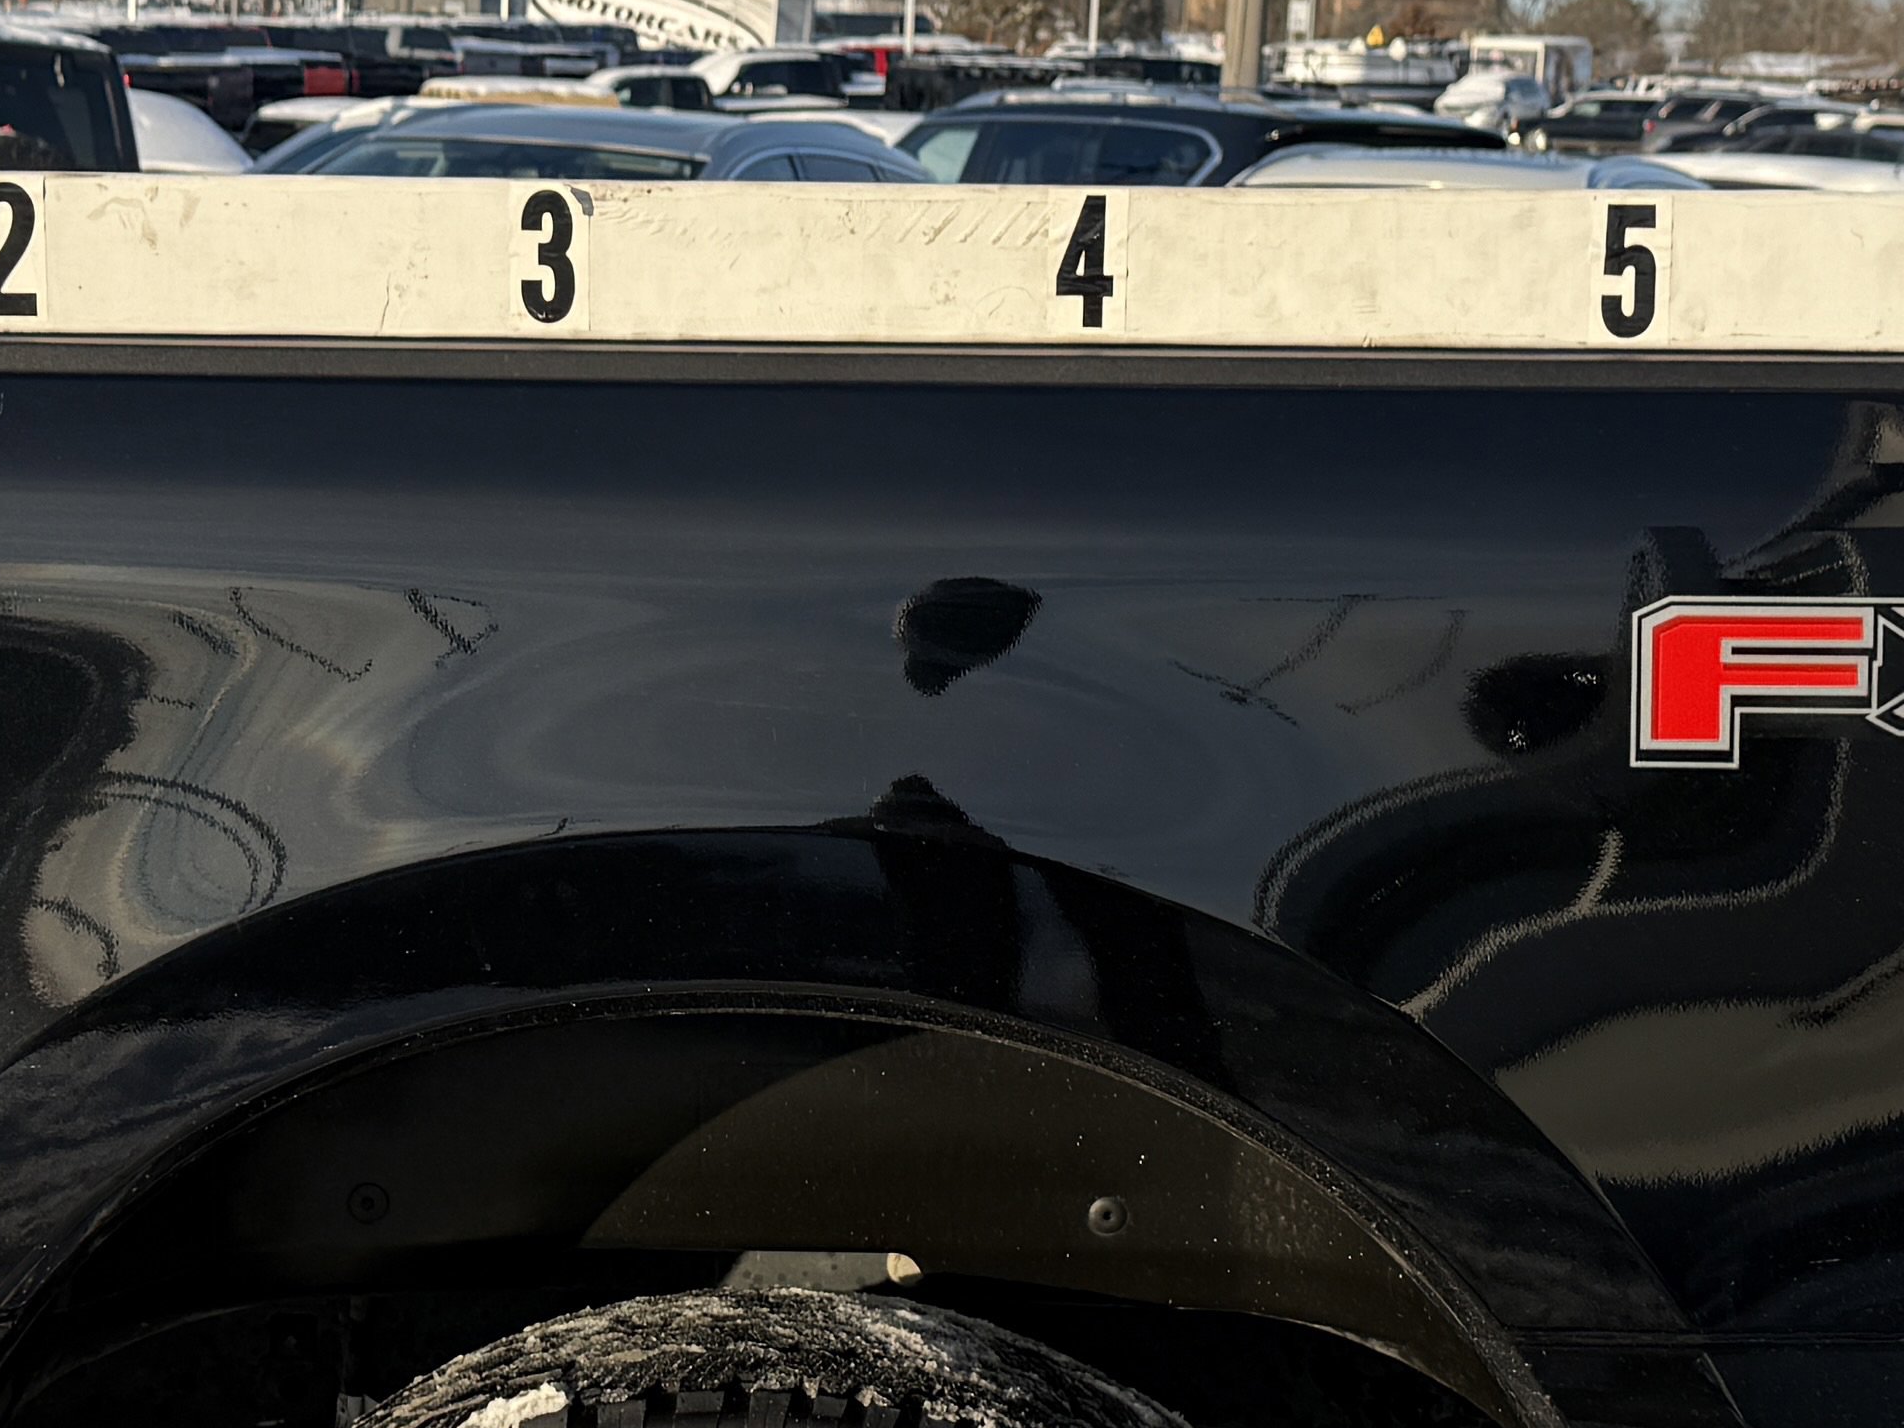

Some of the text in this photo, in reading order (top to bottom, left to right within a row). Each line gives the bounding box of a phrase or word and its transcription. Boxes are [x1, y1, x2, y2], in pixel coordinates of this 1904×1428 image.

[520, 189, 576, 324] 3
[1055, 195, 1114, 328] 4
[1600, 204, 1657, 338] 5
